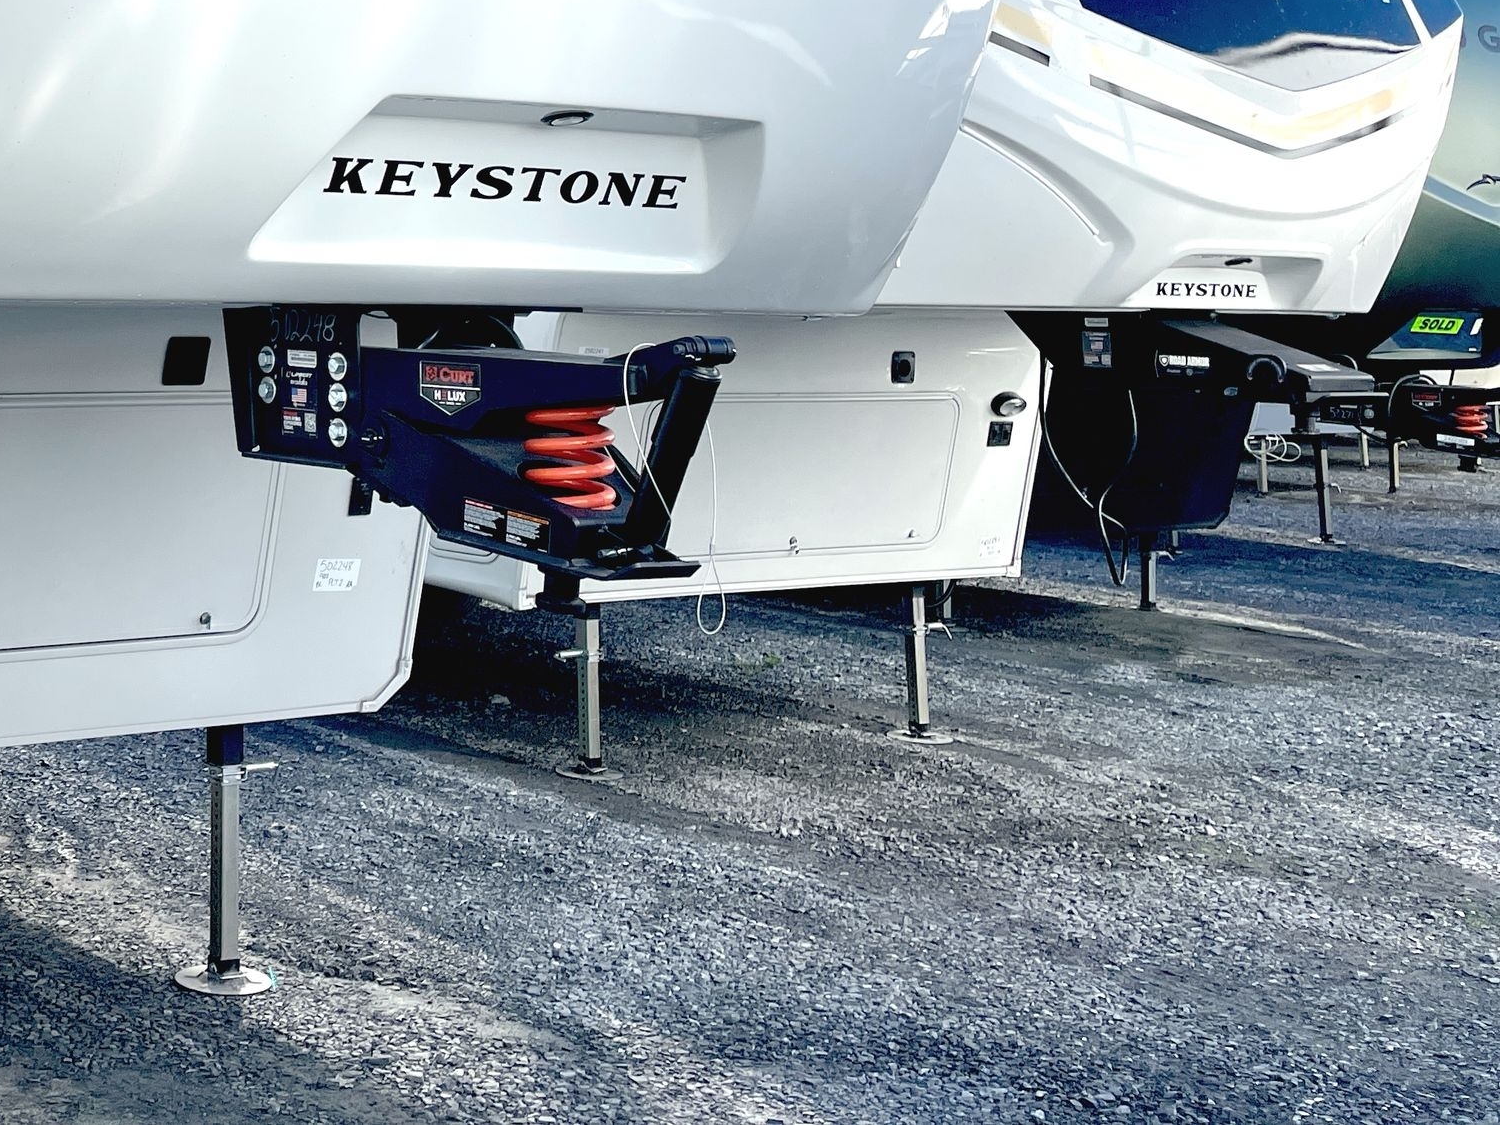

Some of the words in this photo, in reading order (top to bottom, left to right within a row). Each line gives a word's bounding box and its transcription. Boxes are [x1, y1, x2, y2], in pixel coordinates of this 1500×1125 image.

[322, 156, 687, 210] KEYSTONE
[1156, 282, 1258, 298] KEYSTONE
[1419, 318, 1456, 331] SOLD
[439, 366, 475, 385] CURT
